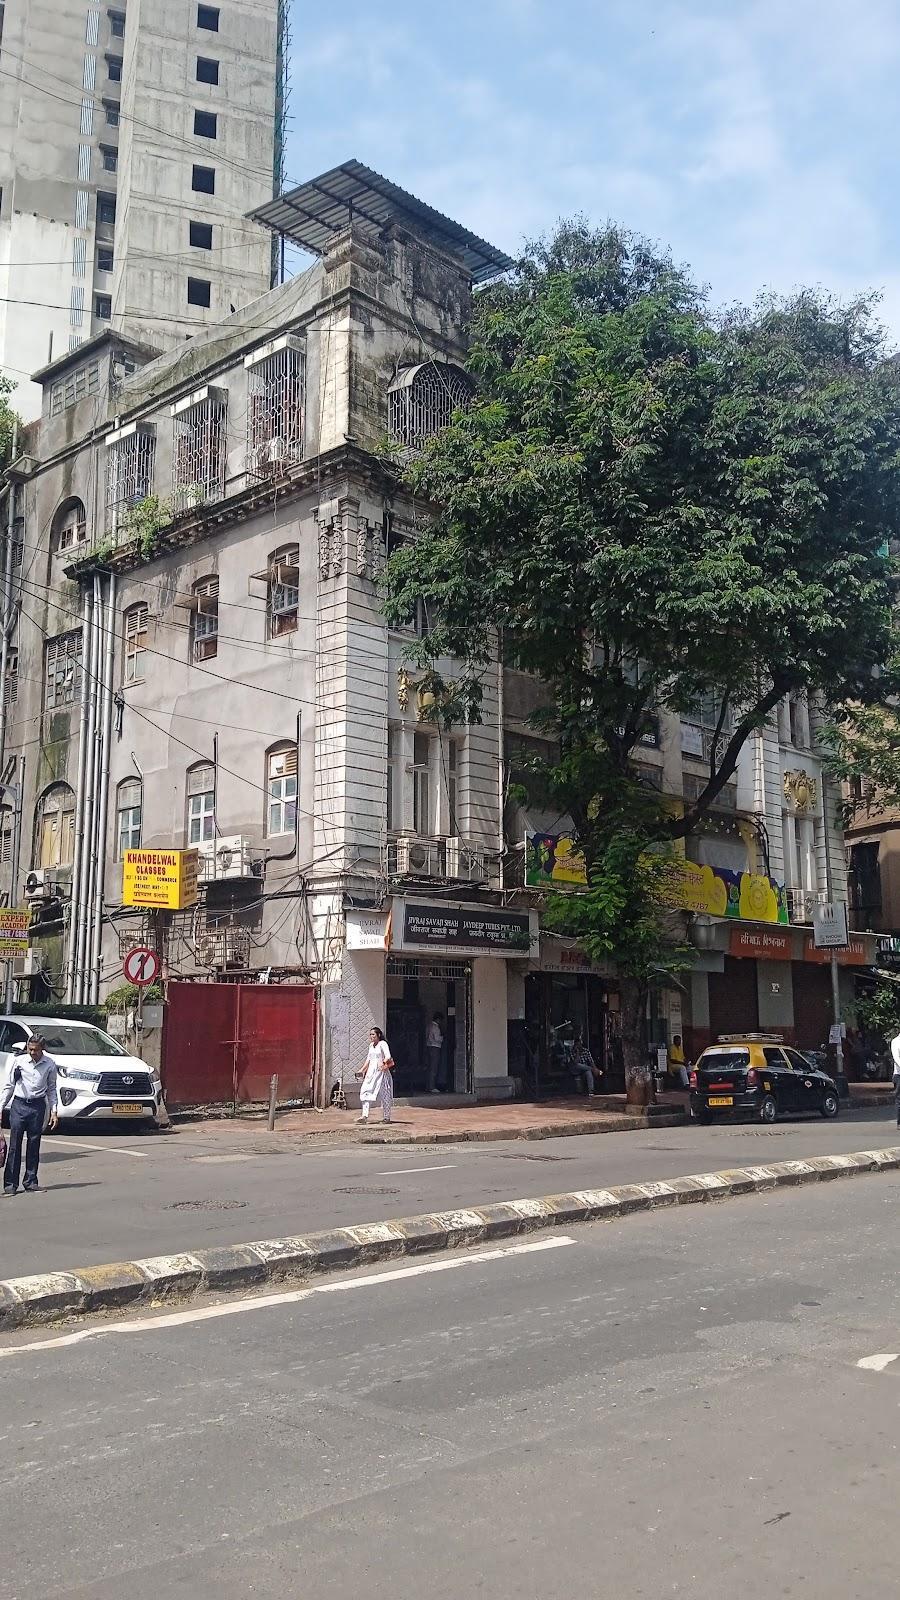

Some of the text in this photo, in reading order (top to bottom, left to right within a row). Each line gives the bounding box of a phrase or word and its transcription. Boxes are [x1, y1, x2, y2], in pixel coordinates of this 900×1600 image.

[127, 853, 177, 866] KHANDELWAL
[136, 866, 166, 875] CLASSES
[0, 914, 29, 923] EXPERT
[408, 916, 425, 926] JIVRAJ
[425, 917, 444, 927] SAVAJI
[444, 919, 459, 927] SHAH
[463, 921, 484, 930] JAYDEEP
[0, 922, 28, 930] ACADEMY
